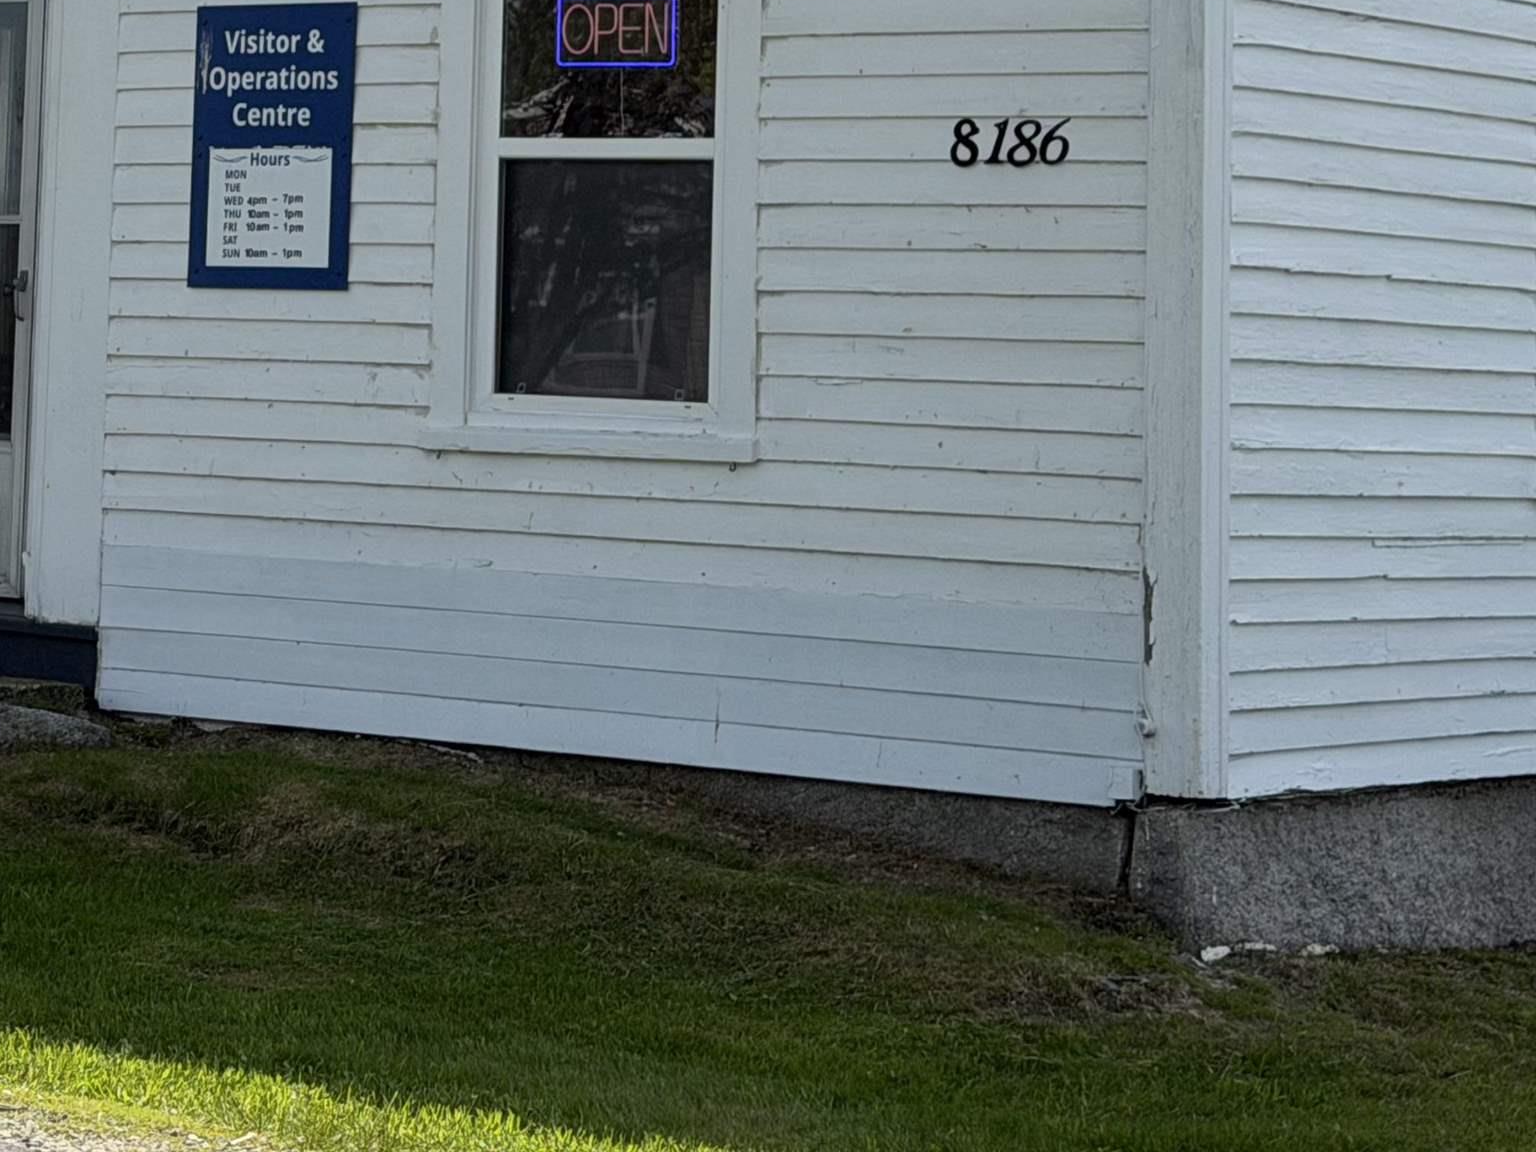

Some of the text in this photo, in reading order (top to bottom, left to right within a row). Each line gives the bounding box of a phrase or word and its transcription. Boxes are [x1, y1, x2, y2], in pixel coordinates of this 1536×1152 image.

[561, 1, 669, 56] OPEN
[224, 28, 325, 54] Visitor &
[209, 64, 339, 98] Operations
[232, 102, 312, 127] Centre
[950, 116, 1072, 167] 8186
[250, 152, 291, 167] Hours
[225, 169, 247, 179] MON
[224, 182, 241, 193] TUE
[224, 195, 244, 206] WED
[247, 196, 268, 207] 4pm
[282, 193, 304, 205] 7pm
[224, 208, 242, 219] THU
[248, 209, 271, 219] 10am
[284, 209, 304, 220] 1pm
[223, 222, 238, 232] FRI
[246, 222, 270, 232] 10am
[222, 235, 238, 245] SAT
[222, 248, 241, 258] SUN
[245, 248, 268, 258] 10am
[282, 248, 303, 259] 1pm
